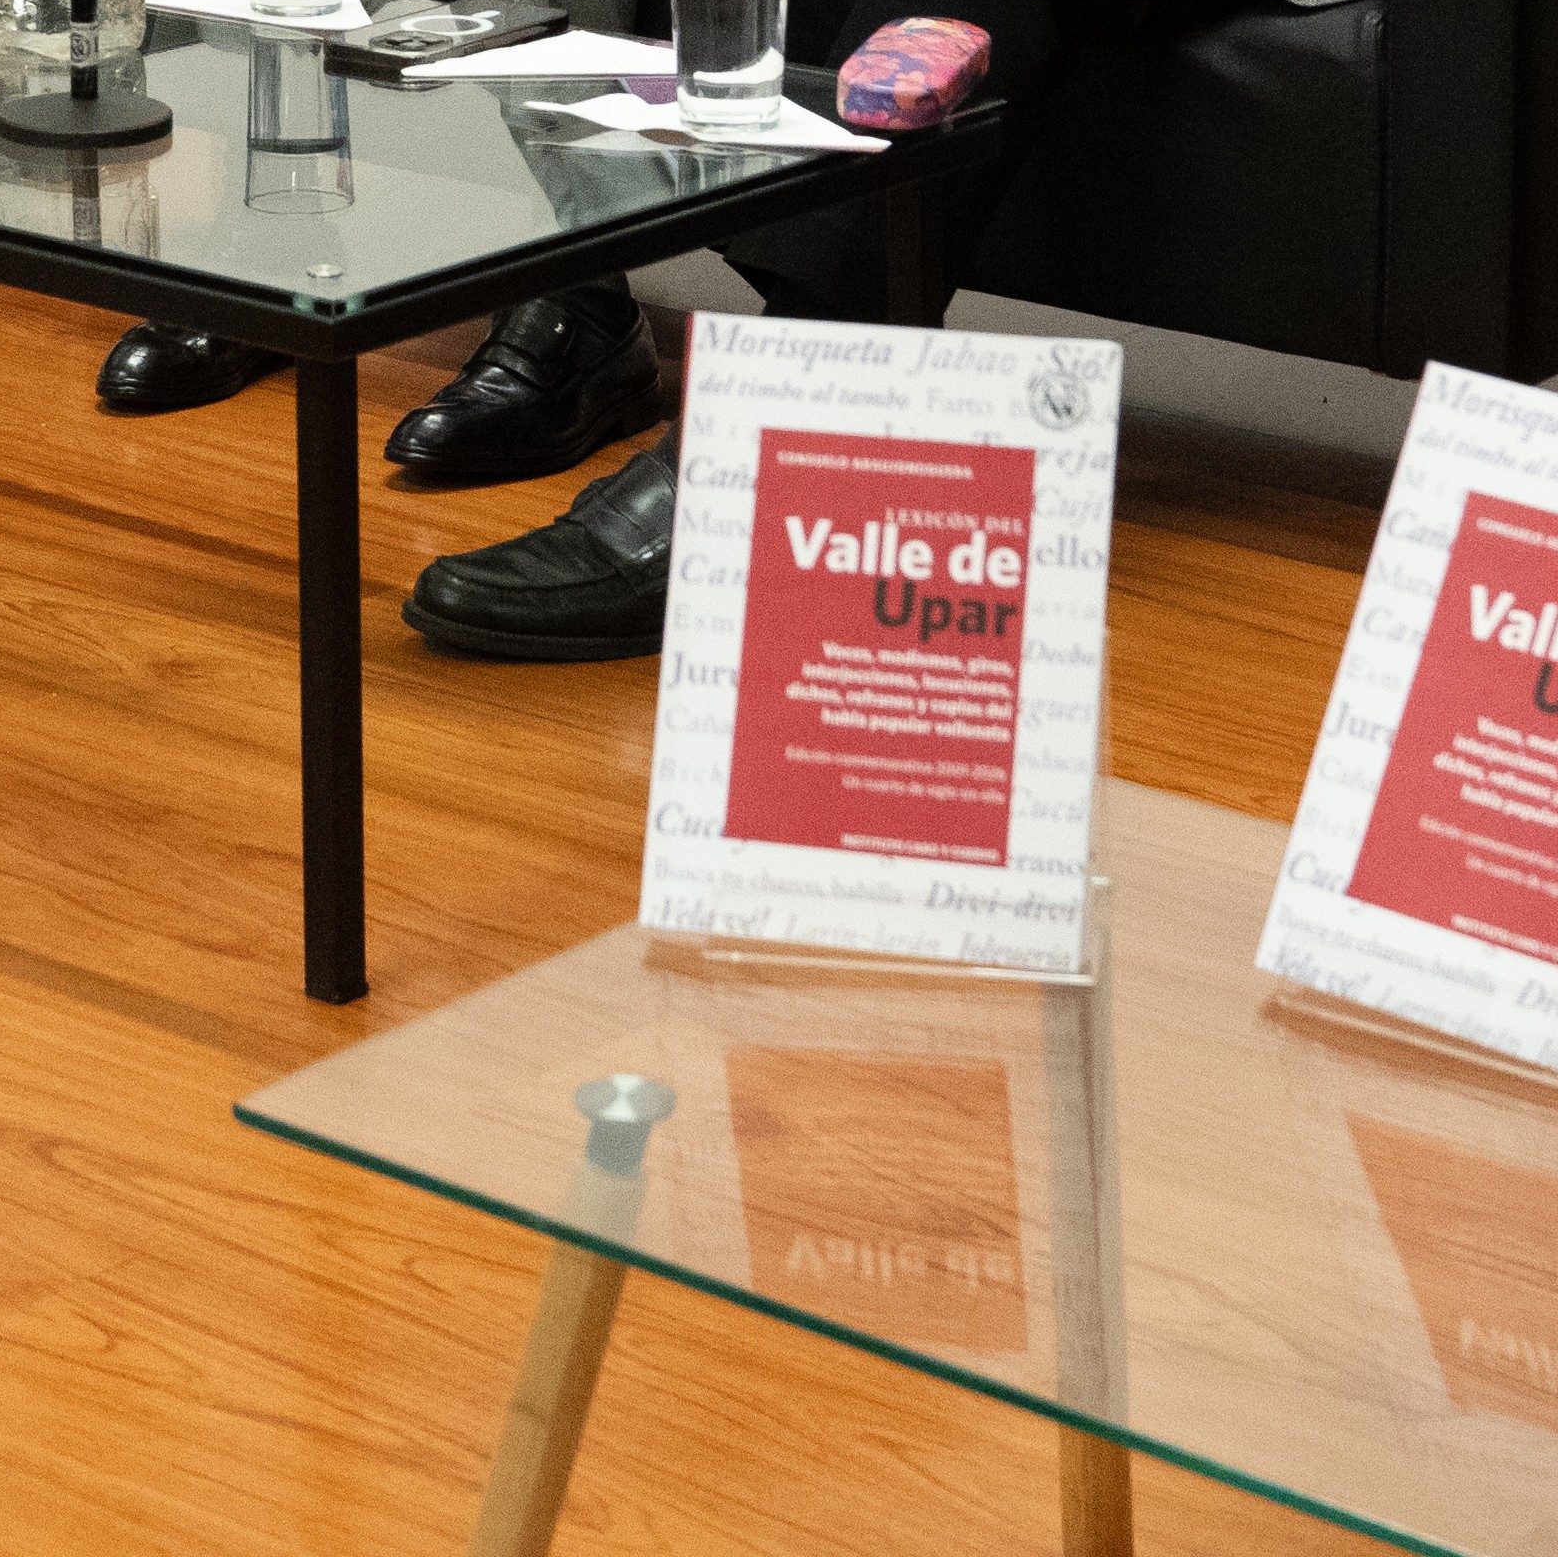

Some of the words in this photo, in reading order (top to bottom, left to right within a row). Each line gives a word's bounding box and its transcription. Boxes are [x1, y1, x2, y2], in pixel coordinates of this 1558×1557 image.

[785, 514, 933, 581] Valle
[947, 530, 1023, 588] de
[871, 579, 1019, 643] Upar
